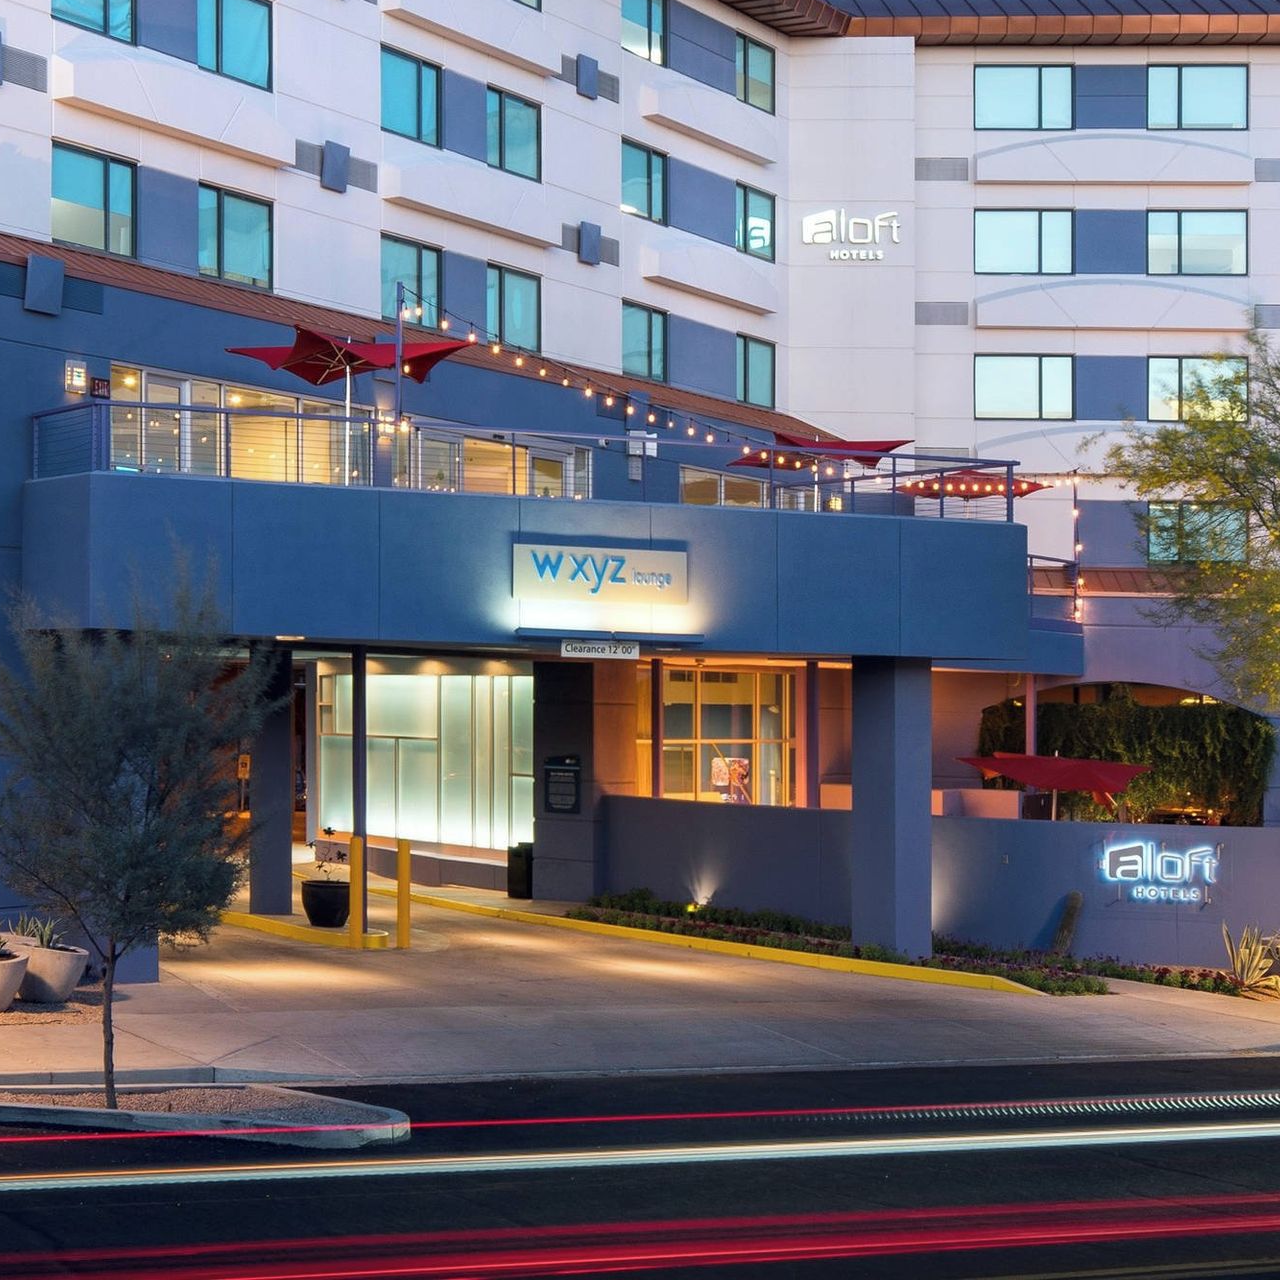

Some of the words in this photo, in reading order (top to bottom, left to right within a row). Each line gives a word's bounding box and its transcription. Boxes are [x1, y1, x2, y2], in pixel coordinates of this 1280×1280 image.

[802, 208, 901, 245] aloft
[830, 249, 885, 261] HOTELS
[632, 568, 672, 590] lounge
[565, 643, 606, 655] Clearance
[1107, 842, 1217, 884] aloft
[1135, 886, 1201, 900] HOTELS
